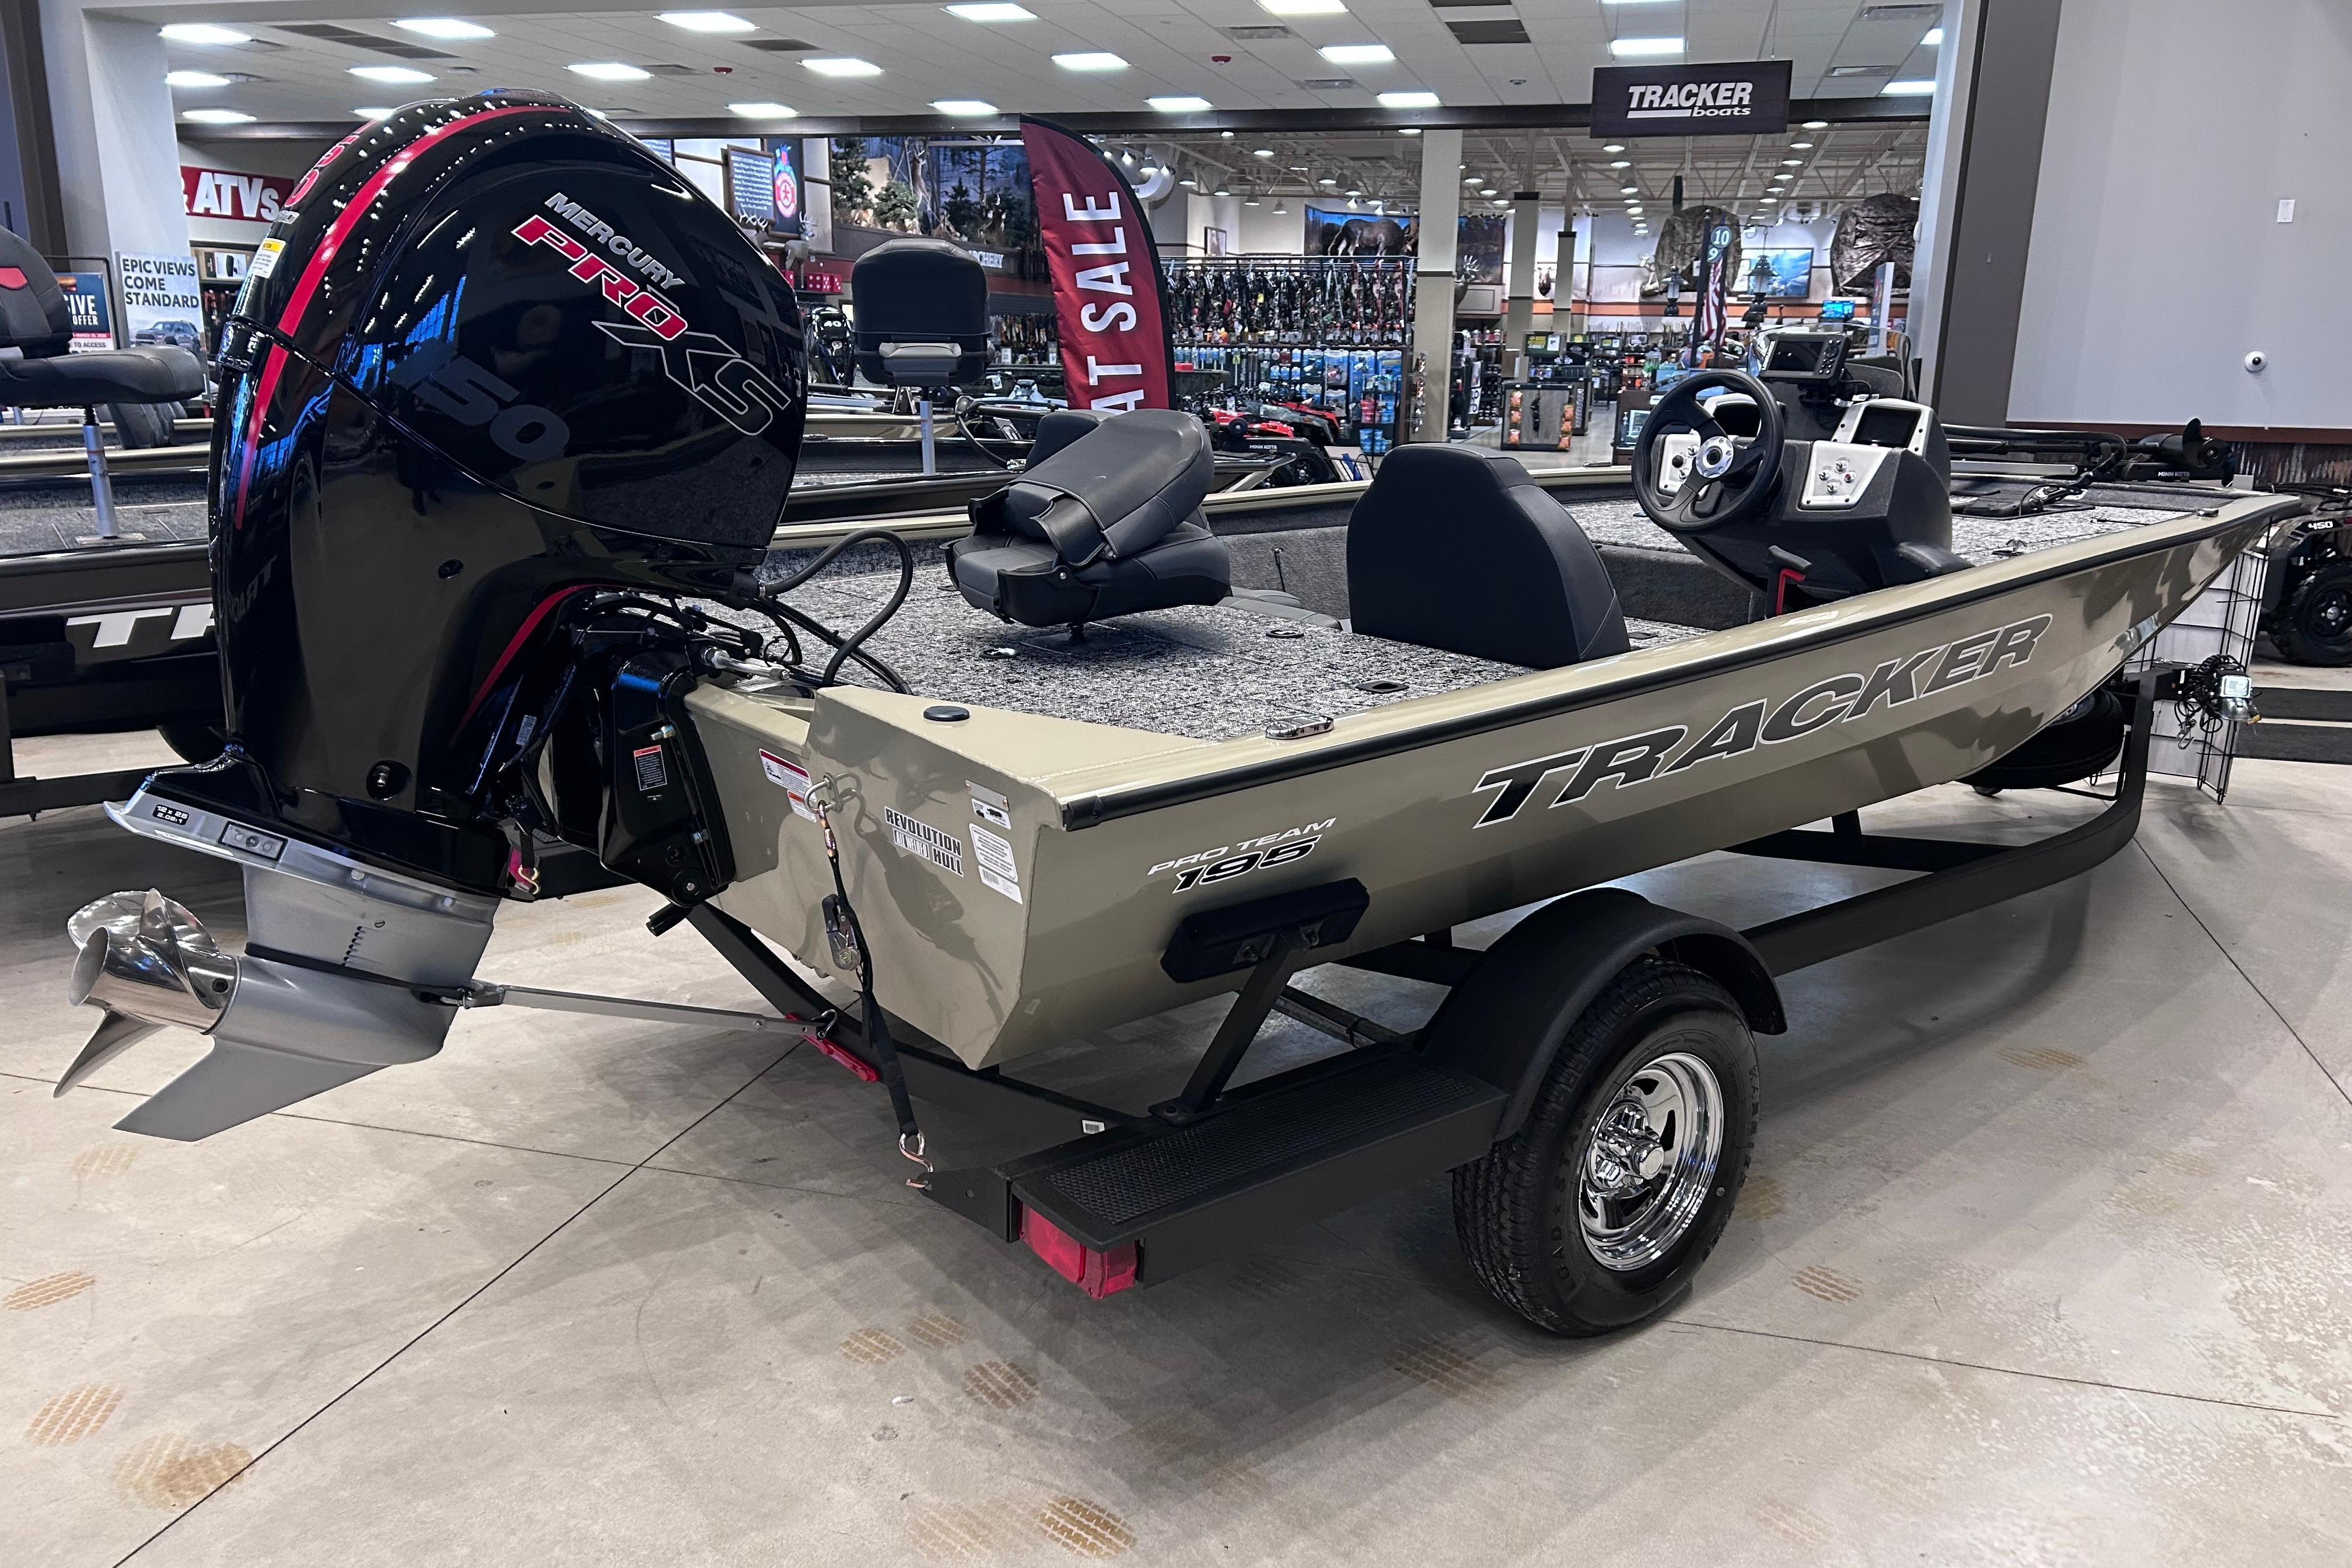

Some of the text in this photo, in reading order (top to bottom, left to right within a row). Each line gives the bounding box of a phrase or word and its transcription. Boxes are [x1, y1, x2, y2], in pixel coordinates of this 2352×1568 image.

[1628, 82, 1753, 108] TRACKER
[1692, 106, 1751, 117] boats
[192, 171, 279, 221] ATVs
[543, 192, 686, 289] MERCURY
[1713, 230, 1730, 245] 10
[122, 258, 195, 276] EPIC VIEWS
[968, 250, 1004, 268] RCHERY
[1062, 191, 1137, 332] SALE
[1707, 247, 1718, 261] 9
[124, 275, 166, 291] COME
[510, 214, 689, 341] PRO
[125, 291, 200, 308] STANDARD
[72, 314, 98, 325] OFFER
[387, 336, 570, 463] 150
[2308, 521, 2333, 530] 450
[1471, 612, 2053, 829] TRACKER
[885, 807, 962, 857] REVOLUTION
[1147, 817, 1337, 876] PRO TEAM
[933, 848, 964, 876] HULL
[1171, 834, 1323, 894] 195
